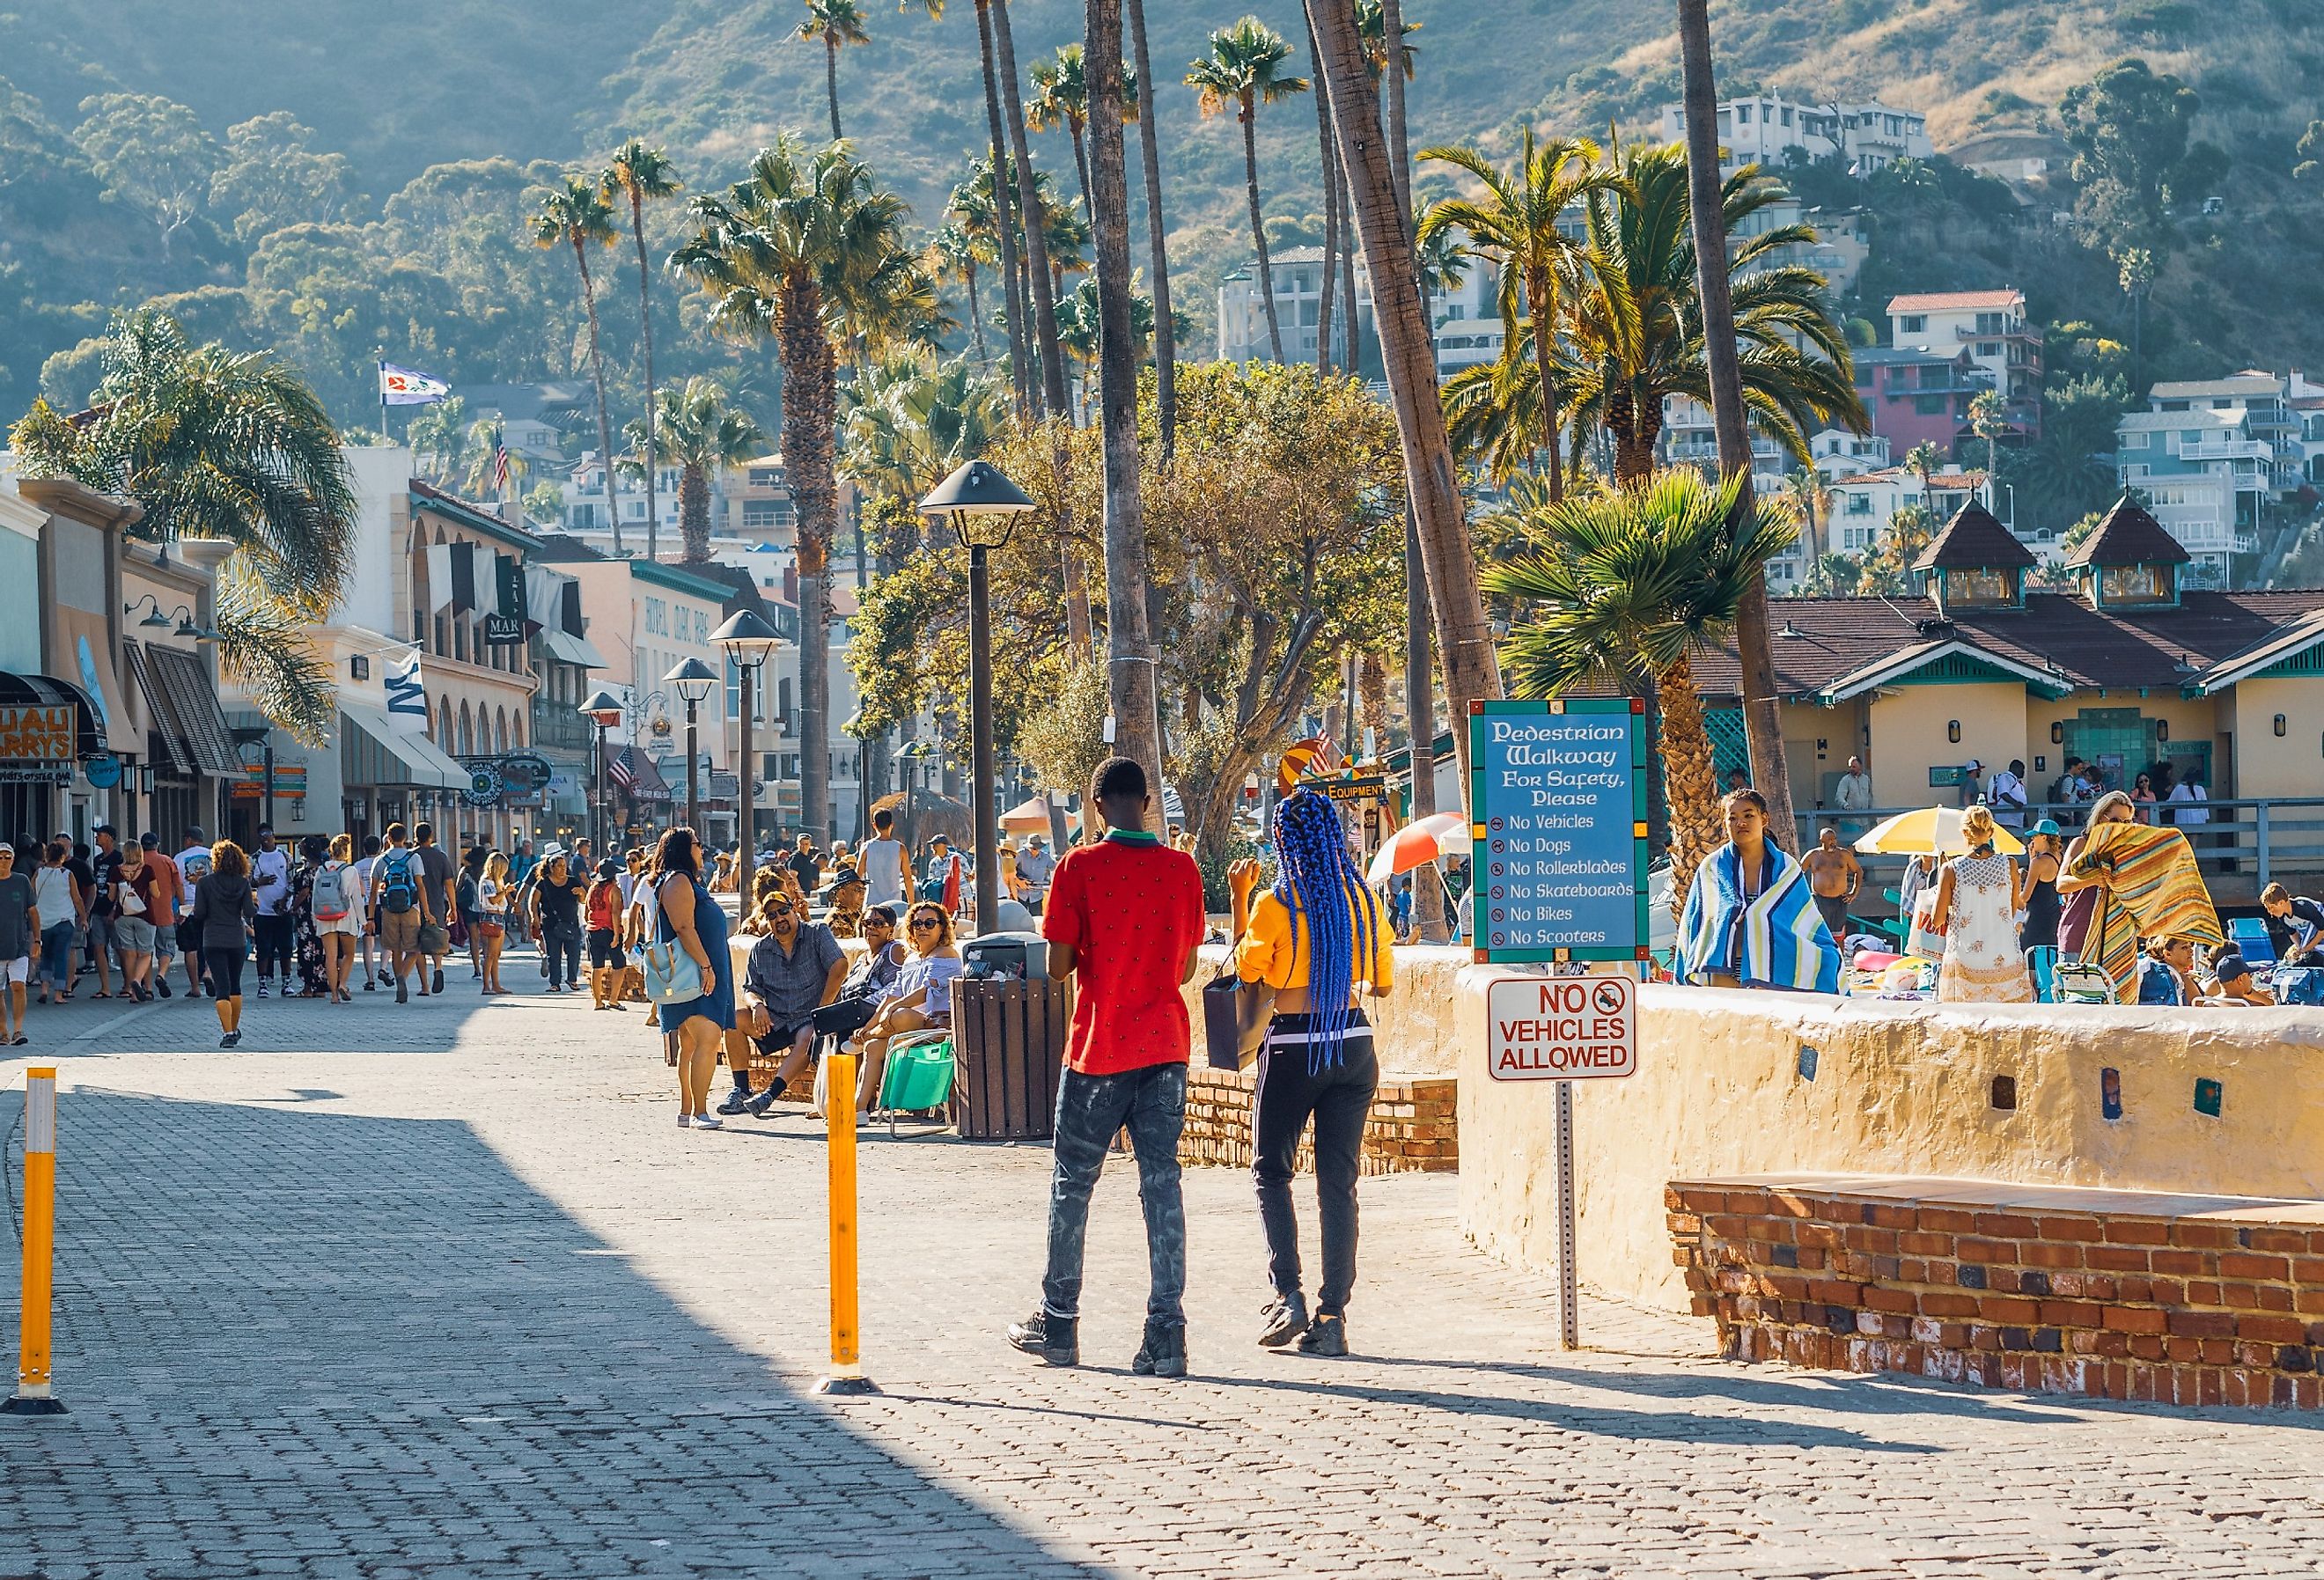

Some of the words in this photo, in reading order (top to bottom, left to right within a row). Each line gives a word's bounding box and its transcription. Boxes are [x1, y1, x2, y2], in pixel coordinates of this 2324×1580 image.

[490, 620, 519, 633] MAR
[1491, 722, 1624, 742] Pedestrian
[1506, 745, 1617, 768] Walkway
[1502, 770, 1541, 787] For
[1548, 770, 1625, 789] Safety,
[1327, 784, 1384, 799] EQUIPMENT
[1531, 790, 1598, 806] Please
[1510, 815, 1530, 829] No
[1535, 813, 1594, 829] Vehicles
[1510, 839, 1530, 853] No
[1535, 838, 1571, 855] Dogs
[1510, 862, 1531, 876] No
[1536, 859, 1626, 875] Rollerblades
[1510, 885, 1531, 899] No
[1536, 882, 1634, 898] Skateboards
[1510, 908, 1531, 921] No
[1536, 907, 1572, 921] Bikes
[1511, 930, 1532, 944] No
[1537, 930, 1606, 944] Scooters
[1540, 984, 1586, 1014] NO
[1499, 1018, 1625, 1042] VEHICLES
[1498, 1045, 1628, 1070] ALLOWED
